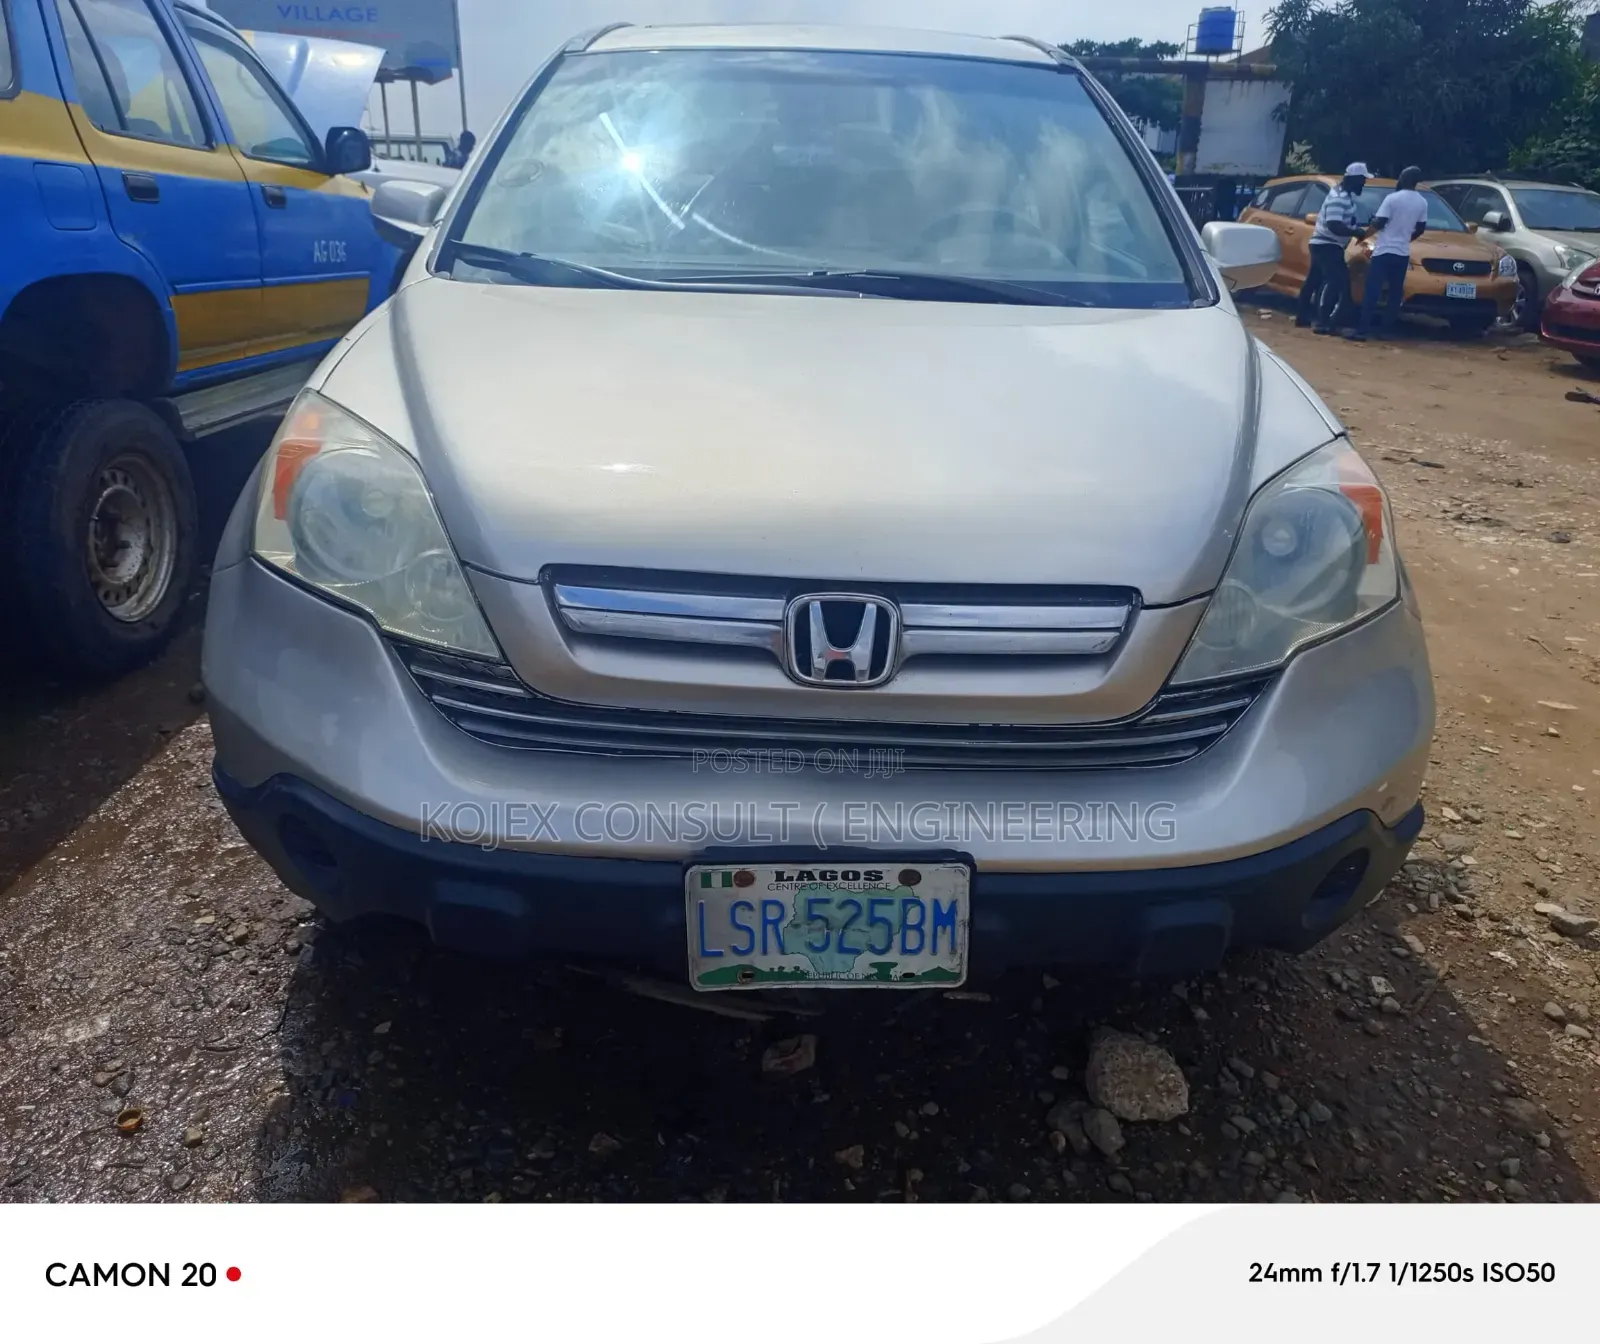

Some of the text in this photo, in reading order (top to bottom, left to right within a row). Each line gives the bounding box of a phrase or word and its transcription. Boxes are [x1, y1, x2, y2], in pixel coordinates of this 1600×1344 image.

[277, 4, 378, 23] VILLAGE
[774, 869, 884, 882] LAGOS
[767, 882, 891, 891] CENTRE OF EXCELLENCE
[699, 897, 958, 957] LSR 525BM
